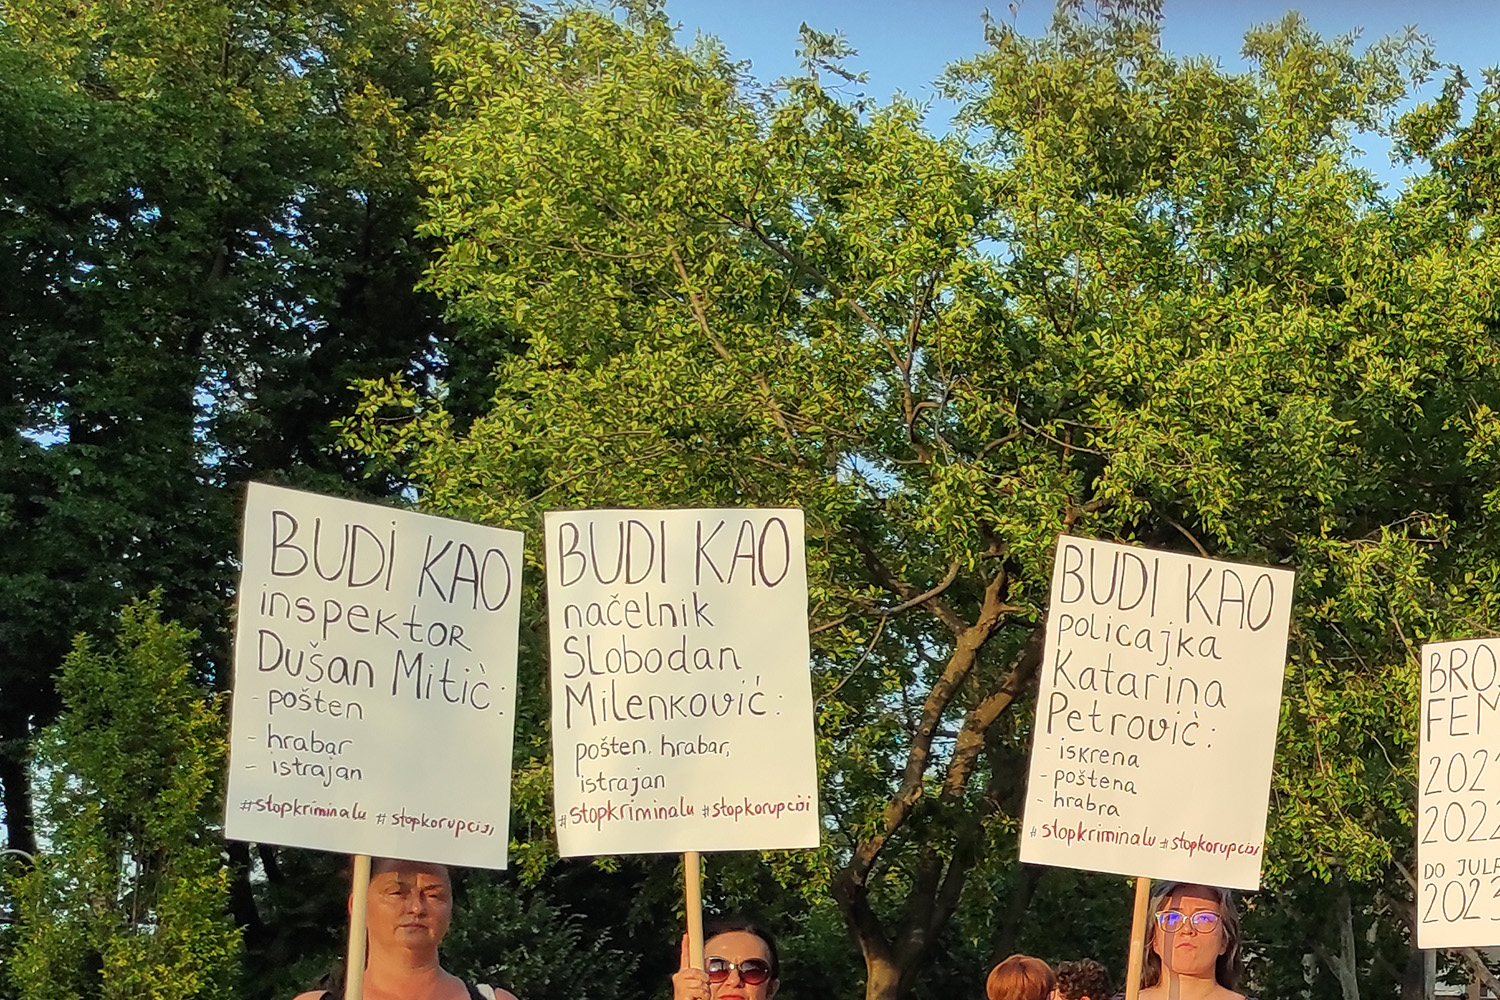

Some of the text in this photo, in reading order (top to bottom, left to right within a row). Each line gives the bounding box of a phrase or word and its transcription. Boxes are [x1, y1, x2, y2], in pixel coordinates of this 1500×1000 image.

[558, 517, 791, 588] BUDI KAO
[418, 534, 511, 612] KAO
[1059, 544, 1275, 632] BUDI KAO
[564, 591, 716, 630] načelnik
[563, 634, 743, 679] Slobodan
[1057, 613, 1222, 666] policajka
[258, 629, 375, 688] Dušan
[1052, 648, 1227, 709] Katarina
[269, 688, 363, 720] pošten
[268, 723, 353, 755] hrabar
[660, 734, 730, 758] hrabar,
[1059, 737, 1140, 768] iskrena
[270, 751, 363, 788] istrajan
[580, 767, 665, 797] istrajan
[1054, 769, 1138, 796] poštena
[1053, 790, 1120, 818] hrabra
[1424, 862, 1445, 880] DO
